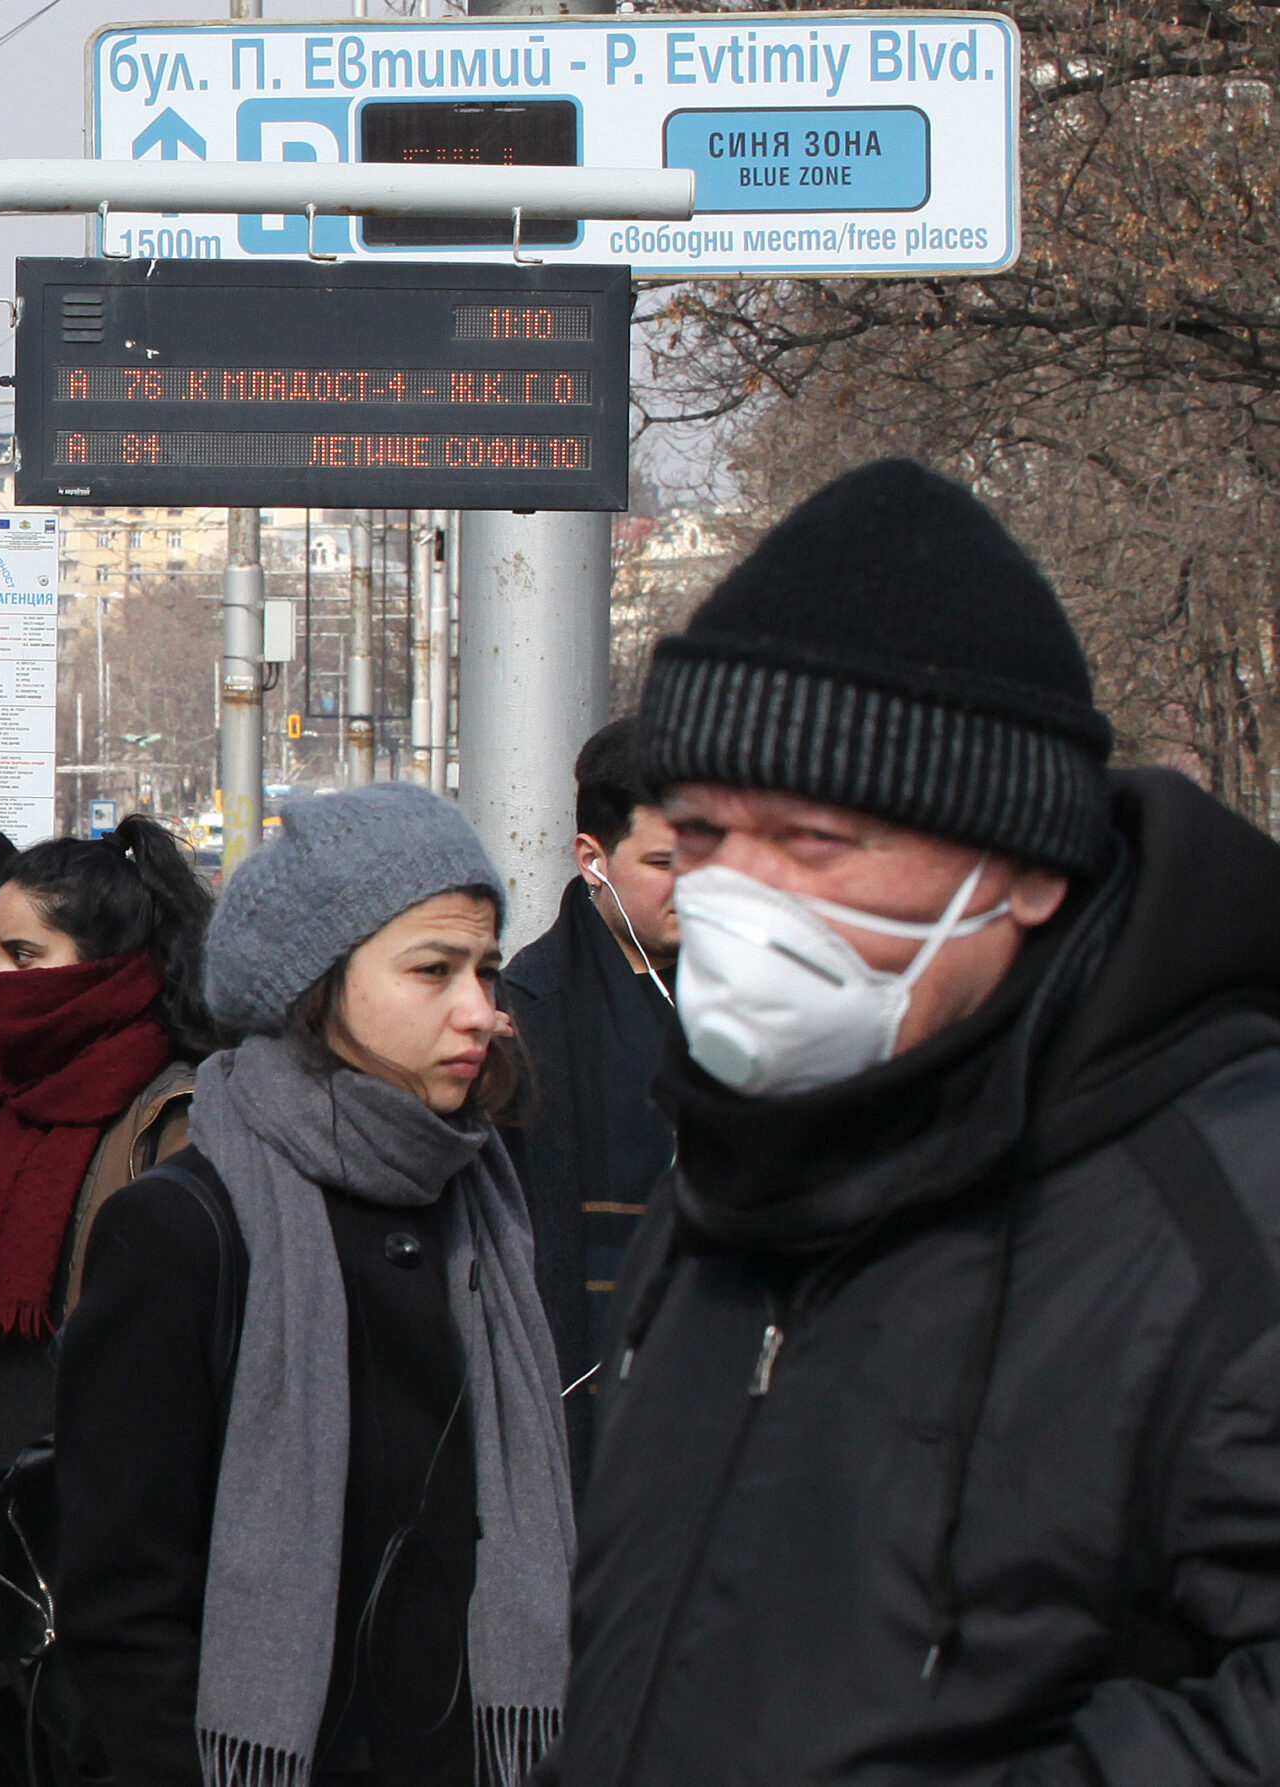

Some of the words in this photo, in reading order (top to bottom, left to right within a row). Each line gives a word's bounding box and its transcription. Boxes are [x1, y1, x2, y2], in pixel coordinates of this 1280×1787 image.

[109, 36, 208, 106] бул.
[231, 38, 281, 90] П.
[305, 35, 551, 90] Евтимий
[606, 33, 643, 86] P.
[666, 30, 851, 98] Evtimiy
[869, 29, 994, 82] Blvd.
[708, 132, 790, 158] СИНЯ
[804, 130, 882, 157] ЗОНА
[739, 167, 790, 187] BLUE
[799, 166, 852, 186] ZONE
[120, 228, 221, 259] 1500m
[609, 225, 734, 259] свободни
[743, 222, 897, 254] места/free
[905, 222, 989, 257] places
[489, 308, 552, 339] 11:10
[123, 370, 164, 400] 76
[222, 371, 406, 402] МЛАДОСТ-4
[121, 434, 162, 464] 84
[308, 435, 431, 467] ЛЕТИЩЕ
